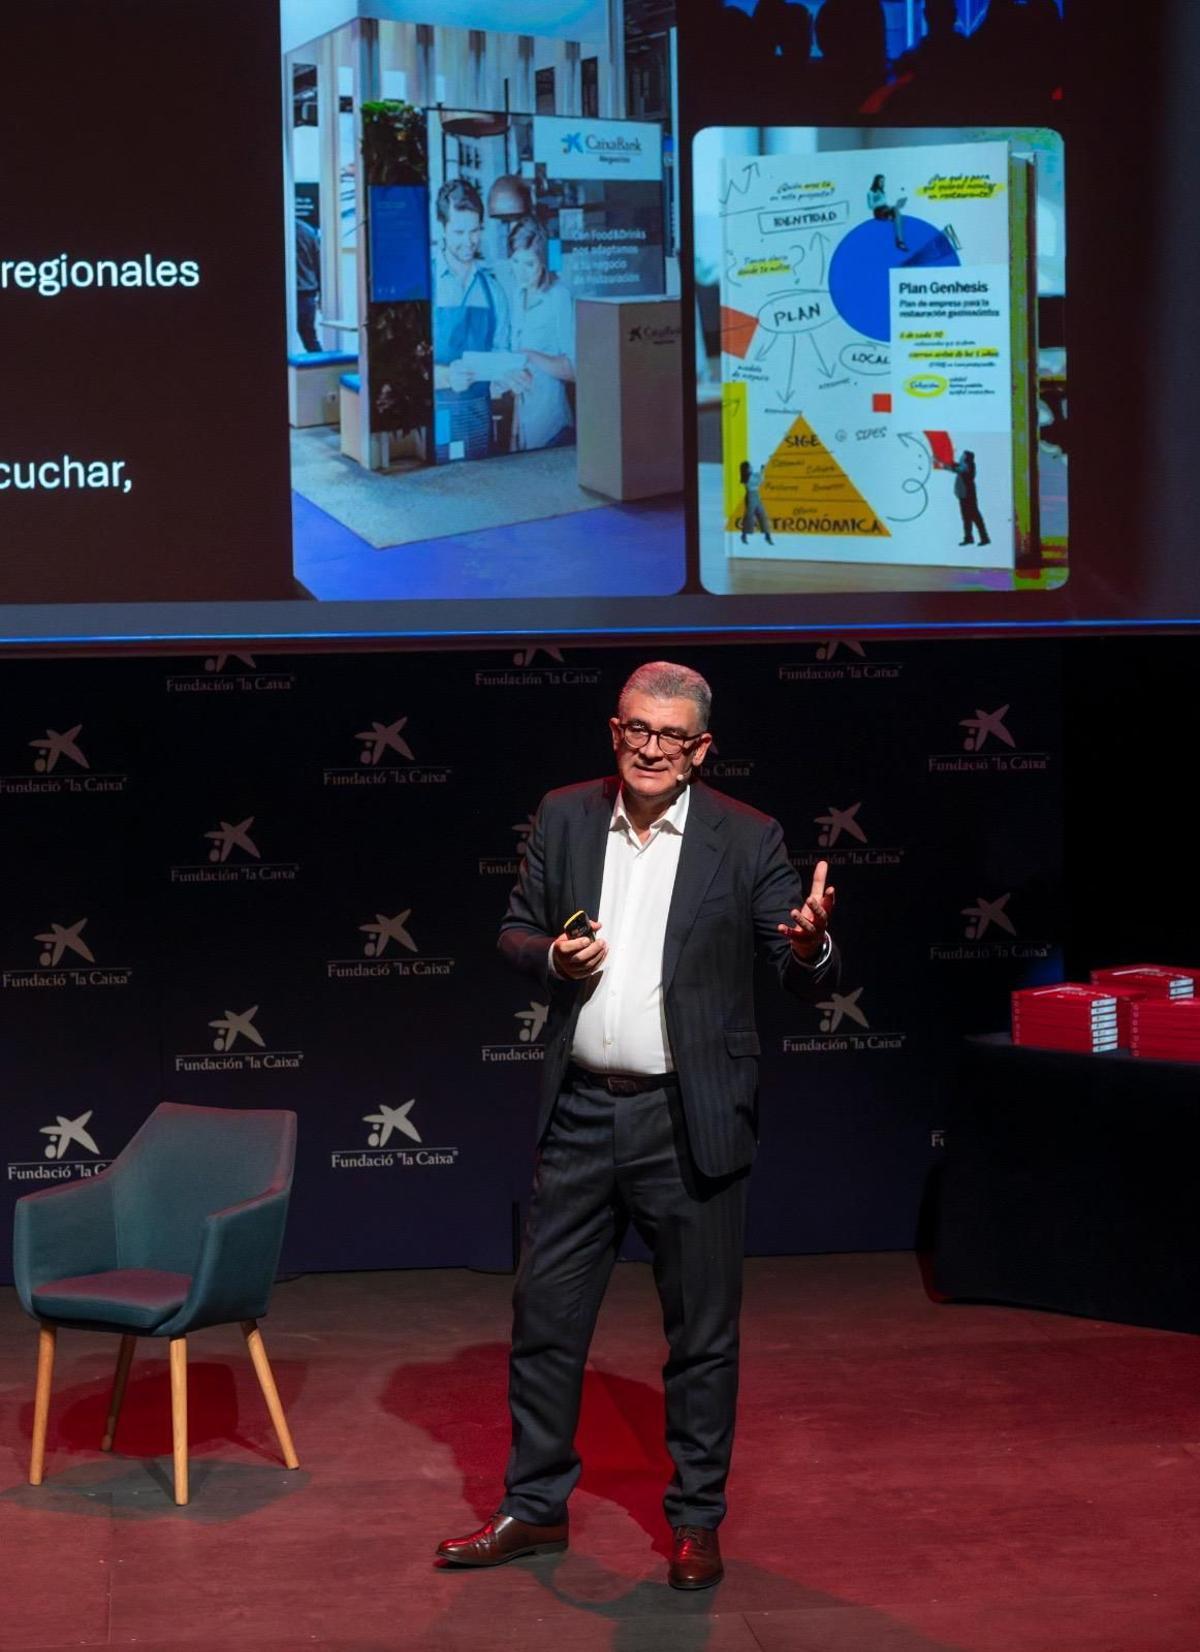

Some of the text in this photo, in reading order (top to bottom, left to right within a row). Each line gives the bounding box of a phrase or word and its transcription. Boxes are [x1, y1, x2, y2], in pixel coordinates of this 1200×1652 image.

[585, 134, 642, 152] CaixaBank
[773, 210, 837, 228] IDENTIDAD
[1, 253, 200, 297] regionales
[899, 280, 988, 295] Plan Genhesis
[899, 298, 990, 309] Plan de empresa para la
[774, 302, 821, 327] PLAN
[851, 353, 890, 365] LOCAL
[735, 513, 884, 533] GTRONÓMICA
[475, 672, 542, 687] Fundación
[778, 666, 844, 681] Fundación
[166, 678, 234, 693] Fundación
[928, 757, 989, 773] Fundació
[323, 771, 386, 786] Fundació
[171, 868, 239, 884] Fundación
[479, 861, 518, 876] Funda
[328, 962, 390, 978] Fundació
[3, 973, 66, 988] Fundació
[783, 1039, 848, 1053] Fundación
[175, 1057, 243, 1072] Fundación
[263, 1055, 304, 1070] Caixa"
[331, 1153, 394, 1169] Fundació
[415, 1150, 460, 1166] Caixa"
[8, 1165, 72, 1180] Fundació
